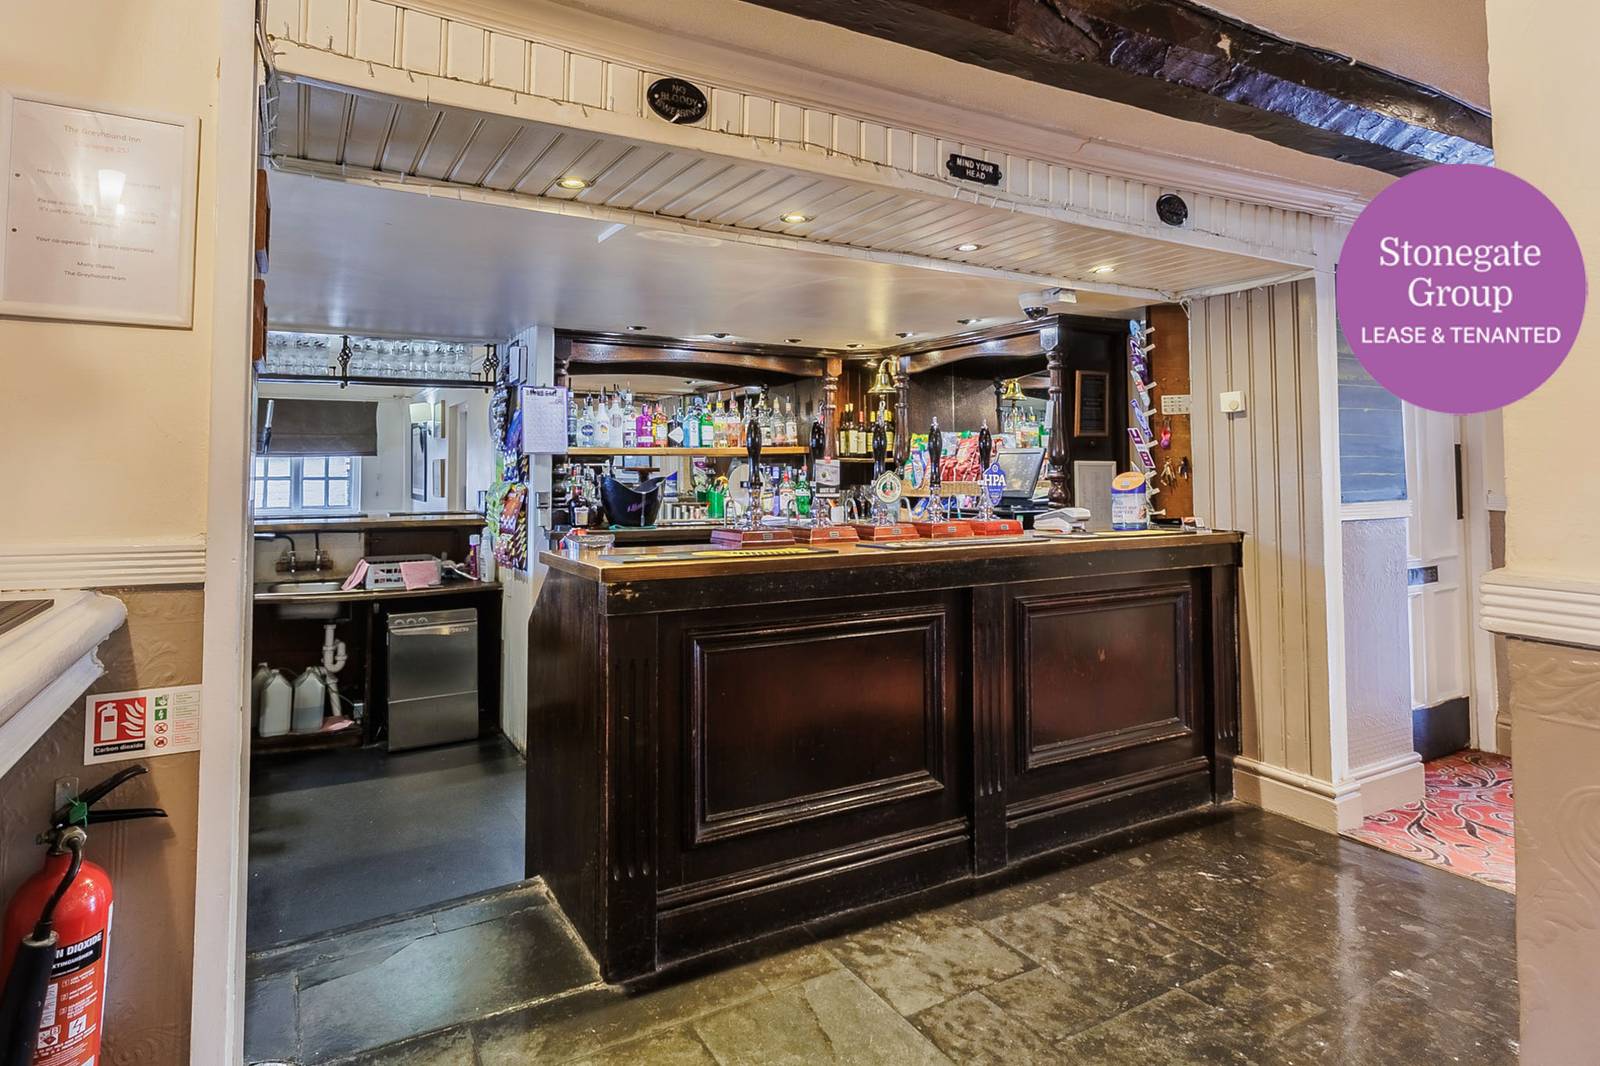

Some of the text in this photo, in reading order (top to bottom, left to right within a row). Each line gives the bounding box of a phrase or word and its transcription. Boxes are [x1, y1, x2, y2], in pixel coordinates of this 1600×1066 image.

[671, 83, 688, 95] NO
[660, 91, 698, 107] BLOODY
[655, 99, 701, 118] SWEARING
[81, 128, 127, 142] Greyhound
[956, 157, 994, 173] MIND YOUR
[966, 169, 986, 180] HEAD
[984, 474, 1007, 486] HPA
[95, 742, 144, 754] Carbon dioxide
[66, 932, 102, 955] DIOXIDE
